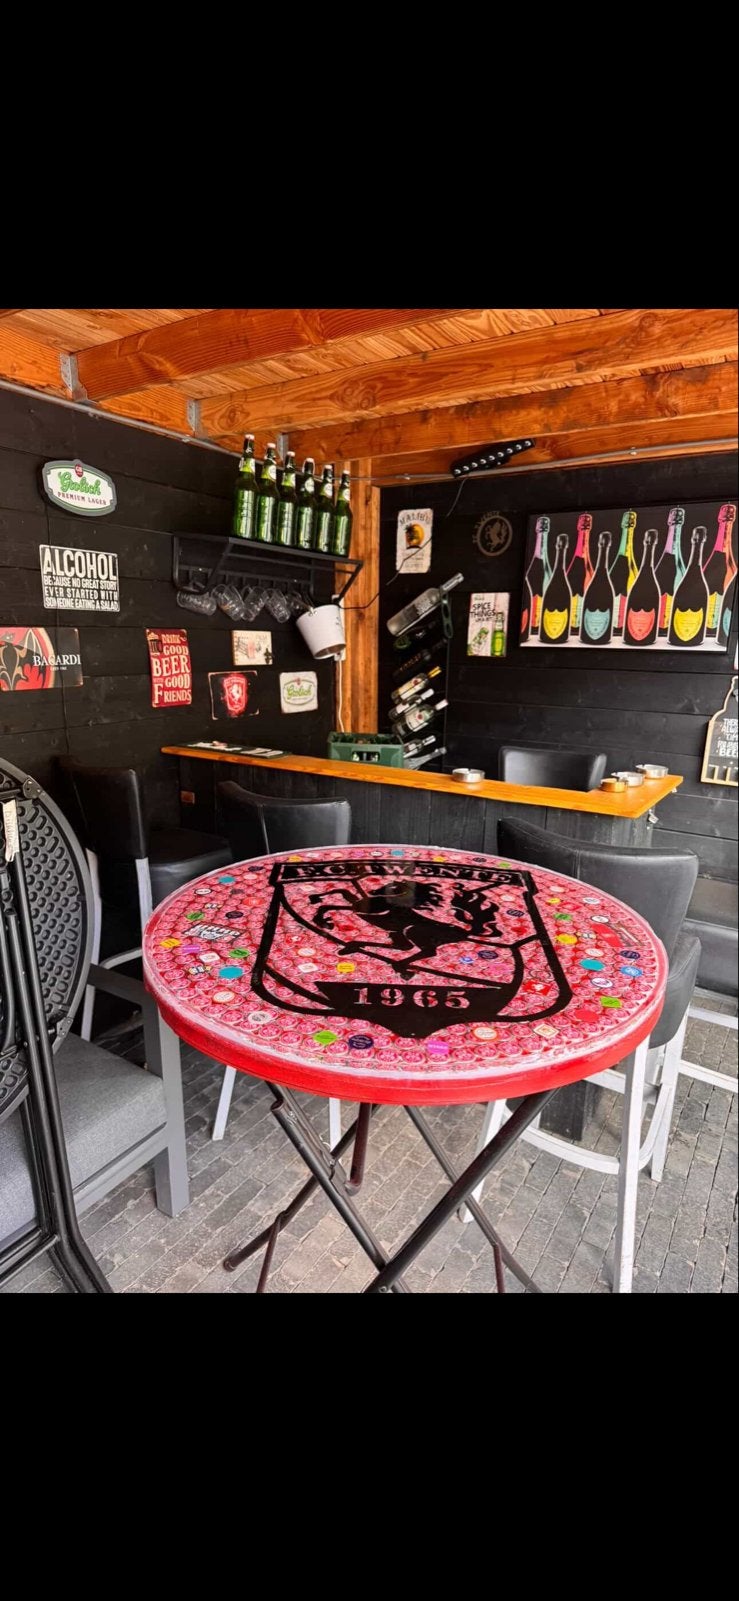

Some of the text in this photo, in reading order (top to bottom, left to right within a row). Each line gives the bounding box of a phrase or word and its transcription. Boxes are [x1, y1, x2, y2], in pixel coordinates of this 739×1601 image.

[57, 491, 86, 502] PREMIUM
[43, 547, 117, 581] ALCOHOL
[72, 578, 81, 588] NO
[81, 579, 100, 590] GREAT
[99, 581, 117, 591] STORY
[44, 586, 119, 601] EVER STARTED WITH
[45, 597, 76, 609] SOMEONE
[75, 599, 96, 610] EATING
[100, 601, 119, 611] SALAD
[472, 601, 492, 611] SPICE
[469, 609, 497, 619] THINGS
[161, 633, 182, 645] DRINK
[162, 644, 190, 656] GOOD
[32, 654, 82, 667] BACARDI
[152, 655, 192, 677] BEER
[164, 673, 191, 689] GOOD
[153, 684, 193, 704] FRIENDS
[356, 864, 513, 884] TWENTE
[353, 987, 471, 1010] 1965
